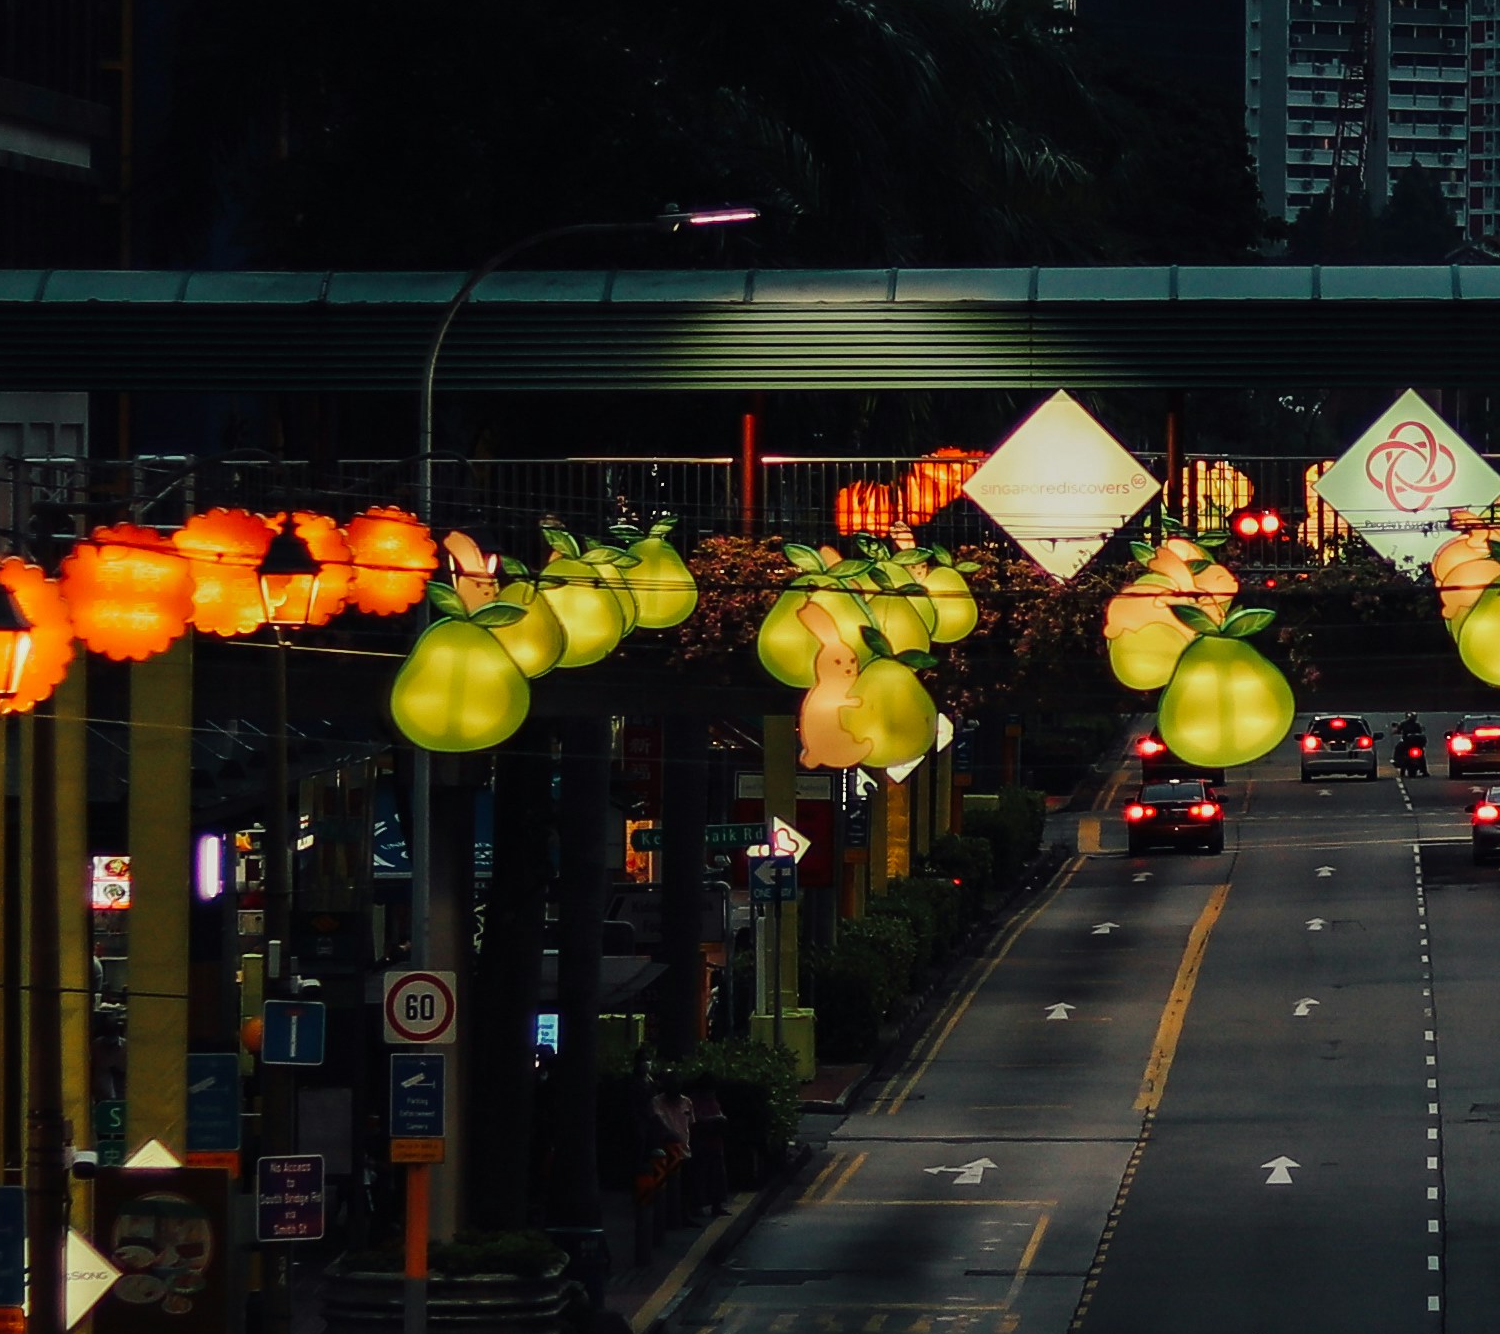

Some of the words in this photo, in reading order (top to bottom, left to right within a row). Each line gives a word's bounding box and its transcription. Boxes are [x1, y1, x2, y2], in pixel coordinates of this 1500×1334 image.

[743, 826, 764, 841] Rd
[753, 888, 772, 898] ONE
[405, 994, 436, 1022] 60
[406, 1097, 428, 1105] Parking
[270, 1163, 282, 1173] No
[283, 1162, 311, 1172] Access
[286, 1179, 296, 1188] to
[260, 1193, 282, 1205] South
[284, 1193, 309, 1206] Bridge
[310, 1191, 322, 1203] Rd
[285, 1210, 297, 1219] via
[273, 1223, 296, 1235] Smith
[298, 1223, 308, 1235] St
